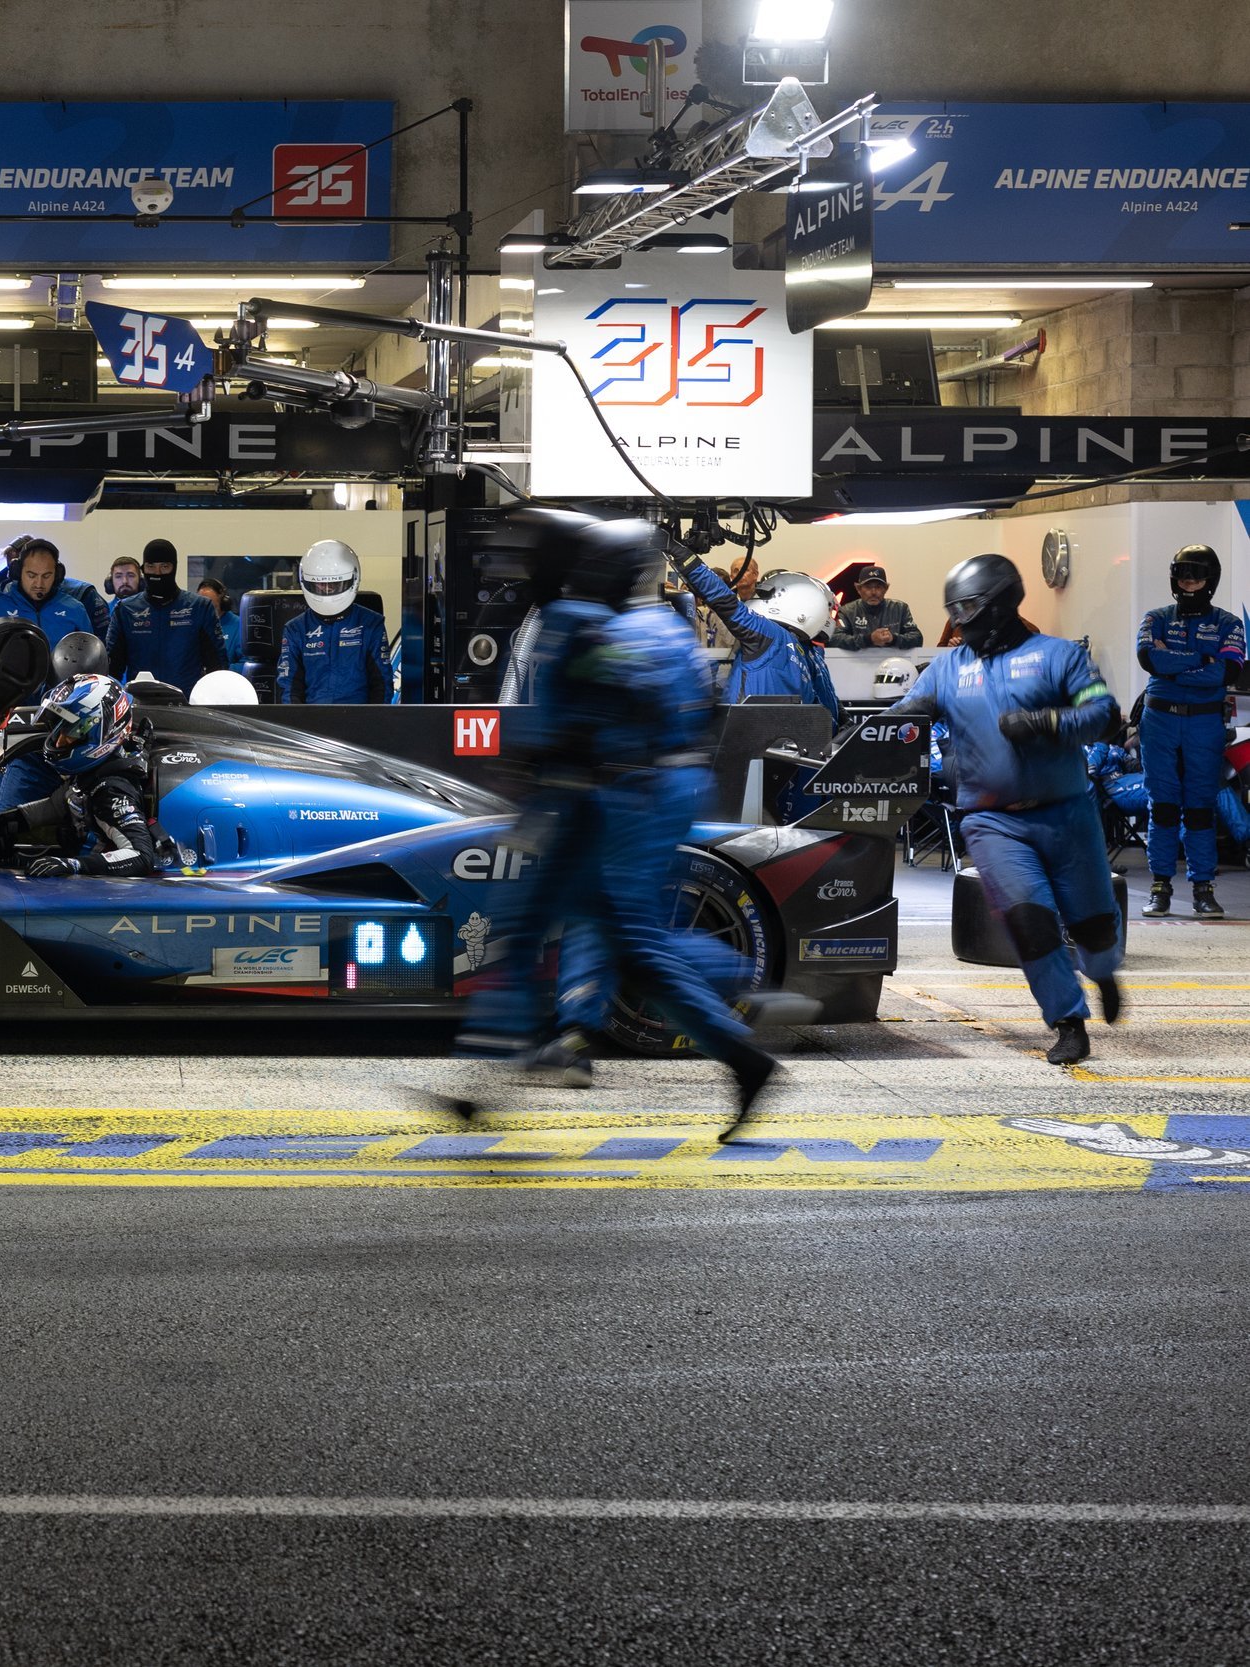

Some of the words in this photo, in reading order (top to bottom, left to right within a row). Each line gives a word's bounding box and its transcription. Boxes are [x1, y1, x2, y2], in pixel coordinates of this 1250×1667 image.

[160, 168, 235, 188] TEAM
[286, 165, 355, 205] 35
[994, 168, 1091, 189] ALPINE
[1094, 168, 1250, 189] ENDURANCE
[28, 201, 69, 213] Alpine
[73, 201, 106, 212] A424
[793, 182, 864, 240] ALPINE
[1121, 202, 1162, 215] Alpine
[1165, 202, 1199, 213] A424
[118, 312, 167, 386] 35
[583, 298, 769, 407] 35
[610, 436, 740, 450] ALPINE
[819, 425, 1209, 464] ALPINE
[456, 718, 497, 748] HY
[860, 725, 898, 742] elf
[813, 782, 918, 794] EURODATACAR
[842, 800, 890, 823] ixell
[833, 879, 854, 887] France
[108, 914, 321, 934] ALPINE
[233, 948, 299, 963] WEC
[824, 946, 885, 955] MICHELIN
[5, 984, 51, 994] DEWESoft
